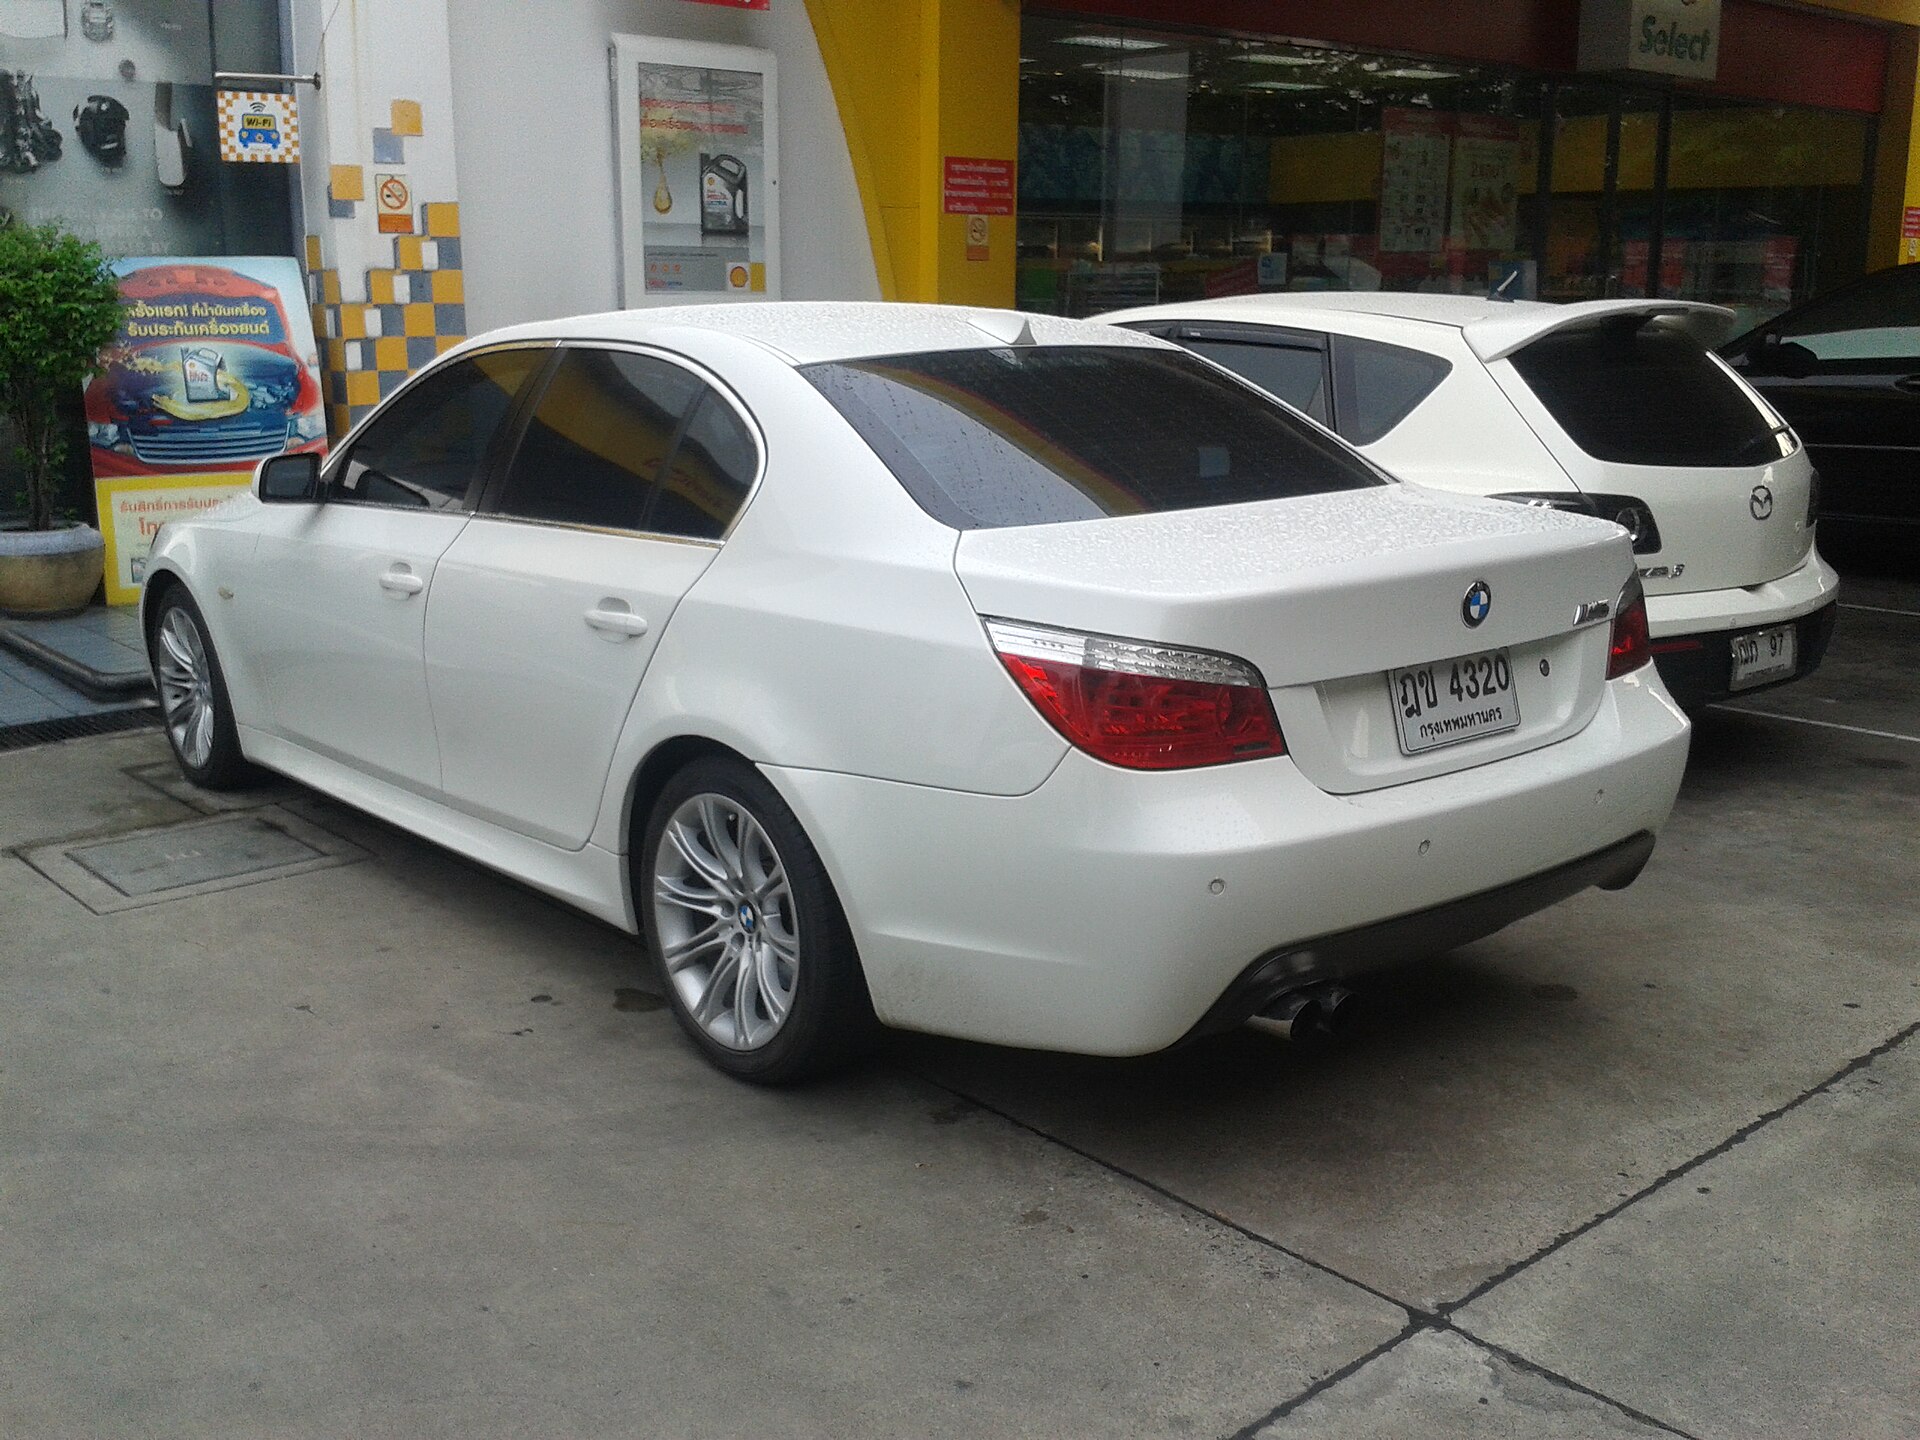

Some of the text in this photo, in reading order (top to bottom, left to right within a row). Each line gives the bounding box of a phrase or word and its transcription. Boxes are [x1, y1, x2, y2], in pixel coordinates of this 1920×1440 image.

[1638, 14, 1710, 62] Select
[128, 318, 270, 337] รับประกันเครื่องยนต์
[1769, 632, 1784, 657] 97
[1400, 653, 1510, 718] ฎข 4320
[1419, 706, 1503, 741] กรุงเทพมหานคร
